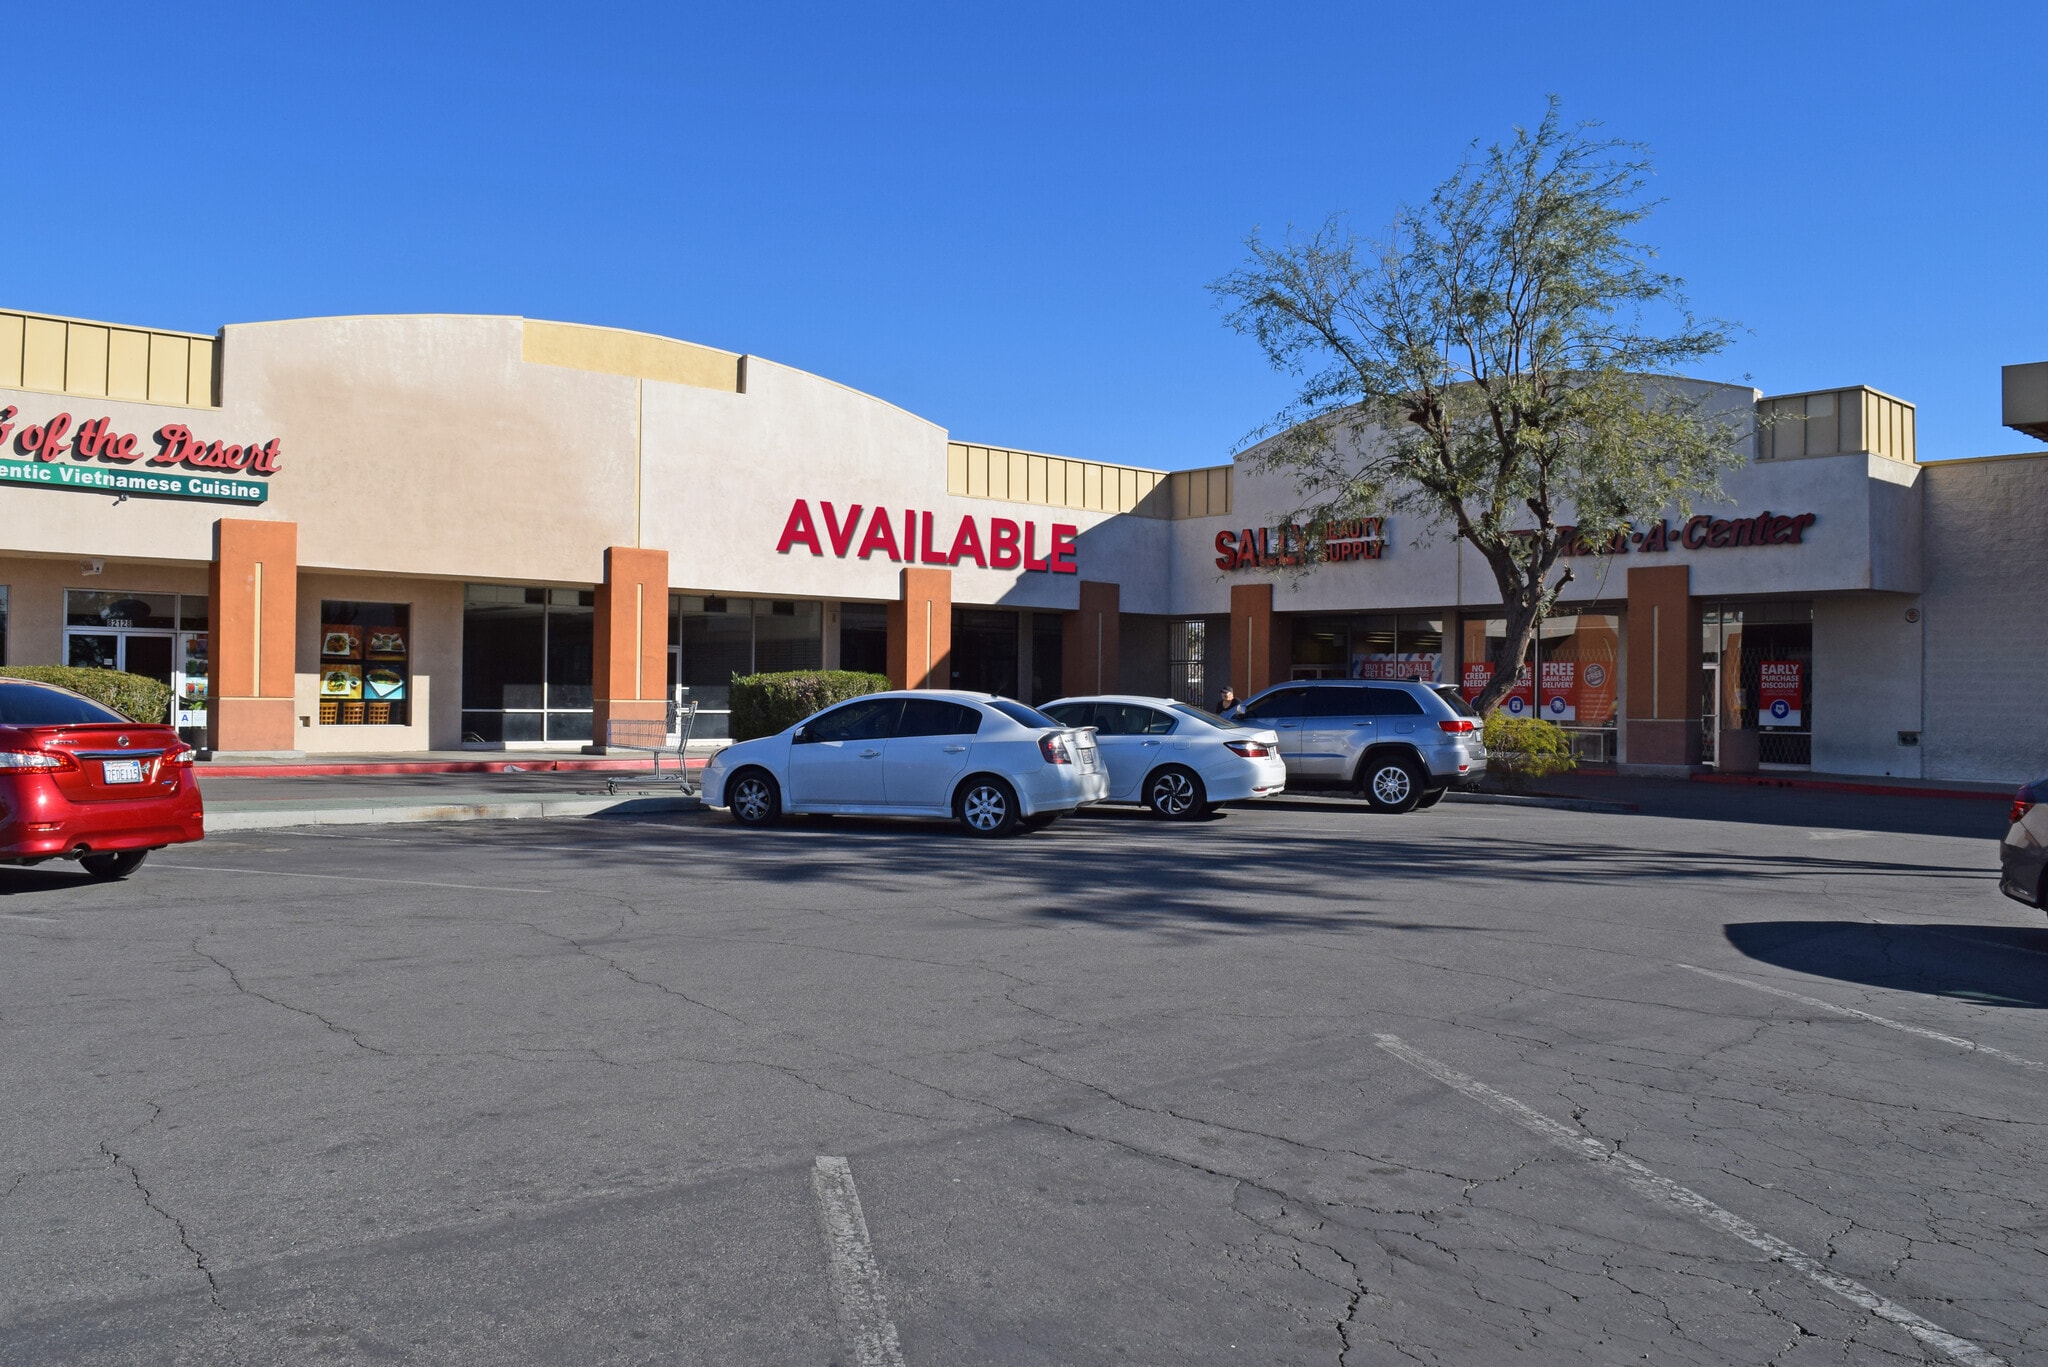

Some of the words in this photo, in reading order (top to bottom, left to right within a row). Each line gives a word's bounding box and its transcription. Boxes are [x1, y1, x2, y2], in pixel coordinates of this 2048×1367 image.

[22, 412, 71, 462] of
[79, 416, 144, 460] the
[153, 423, 282, 472] Desert
[0, 464, 51, 481] entic
[58, 467, 182, 492] Vietnamese
[188, 478, 260, 498] Cuisine
[1320, 517, 1382, 540] EAUTY
[776, 498, 1077, 573] AVAILABLE
[1414, 663, 1429, 671] ALL
[1472, 664, 1484, 672] NO
[1542, 662, 1574, 676] FREE
[1761, 664, 1799, 675] EARLY
[1465, 672, 1491, 680] CREDIT
[1463, 679, 1490, 687] NEEDE
[181, 714, 189, 722] A
